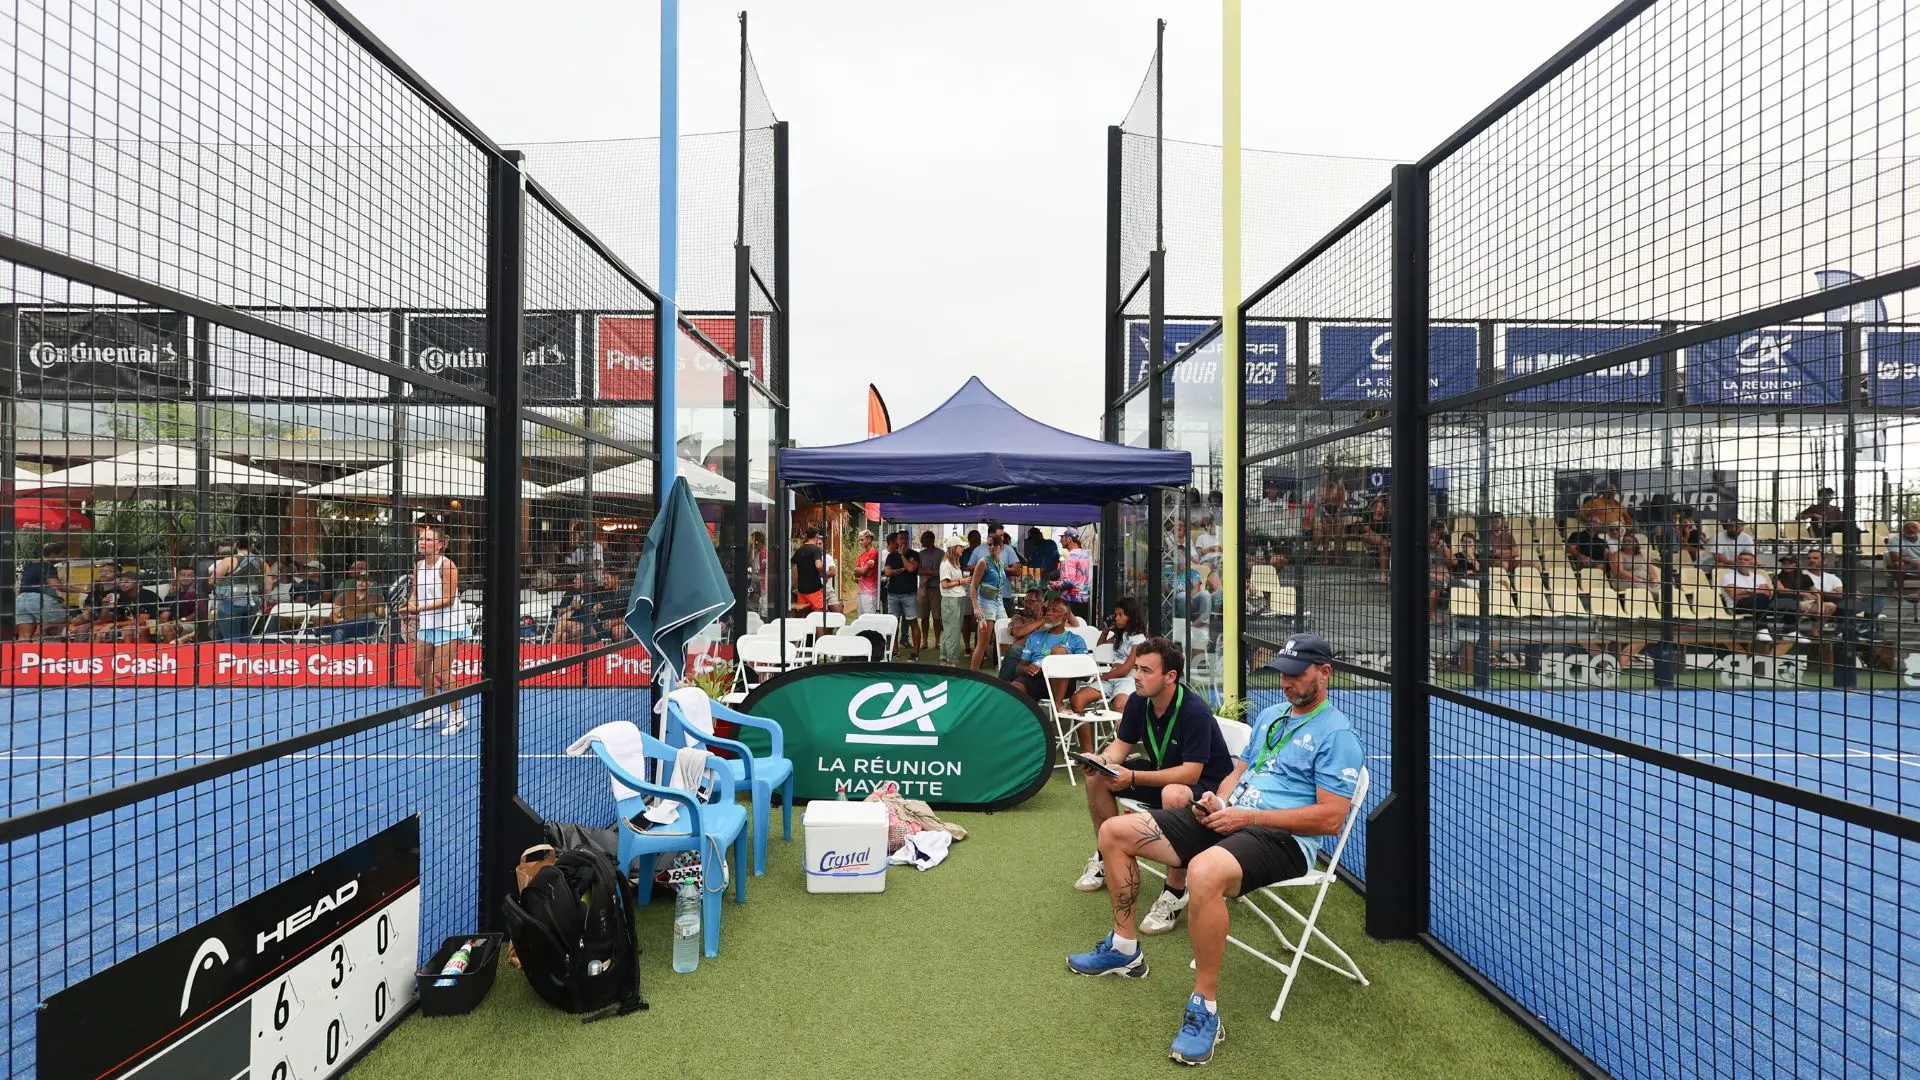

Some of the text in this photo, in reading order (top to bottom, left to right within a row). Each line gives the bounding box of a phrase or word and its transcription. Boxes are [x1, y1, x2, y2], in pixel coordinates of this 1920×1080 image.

[30, 341, 158, 368] Continental
[21, 653, 177, 675] Pneus Cash
[218, 653, 374, 675] Pneus Cash
[818, 755, 962, 776] LA RÉUNION
[819, 847, 871, 873] Crystal
[256, 879, 359, 955] HEAD
[273, 913, 389, 1031] 6 3 0
[325, 981, 386, 1066] 0 0
